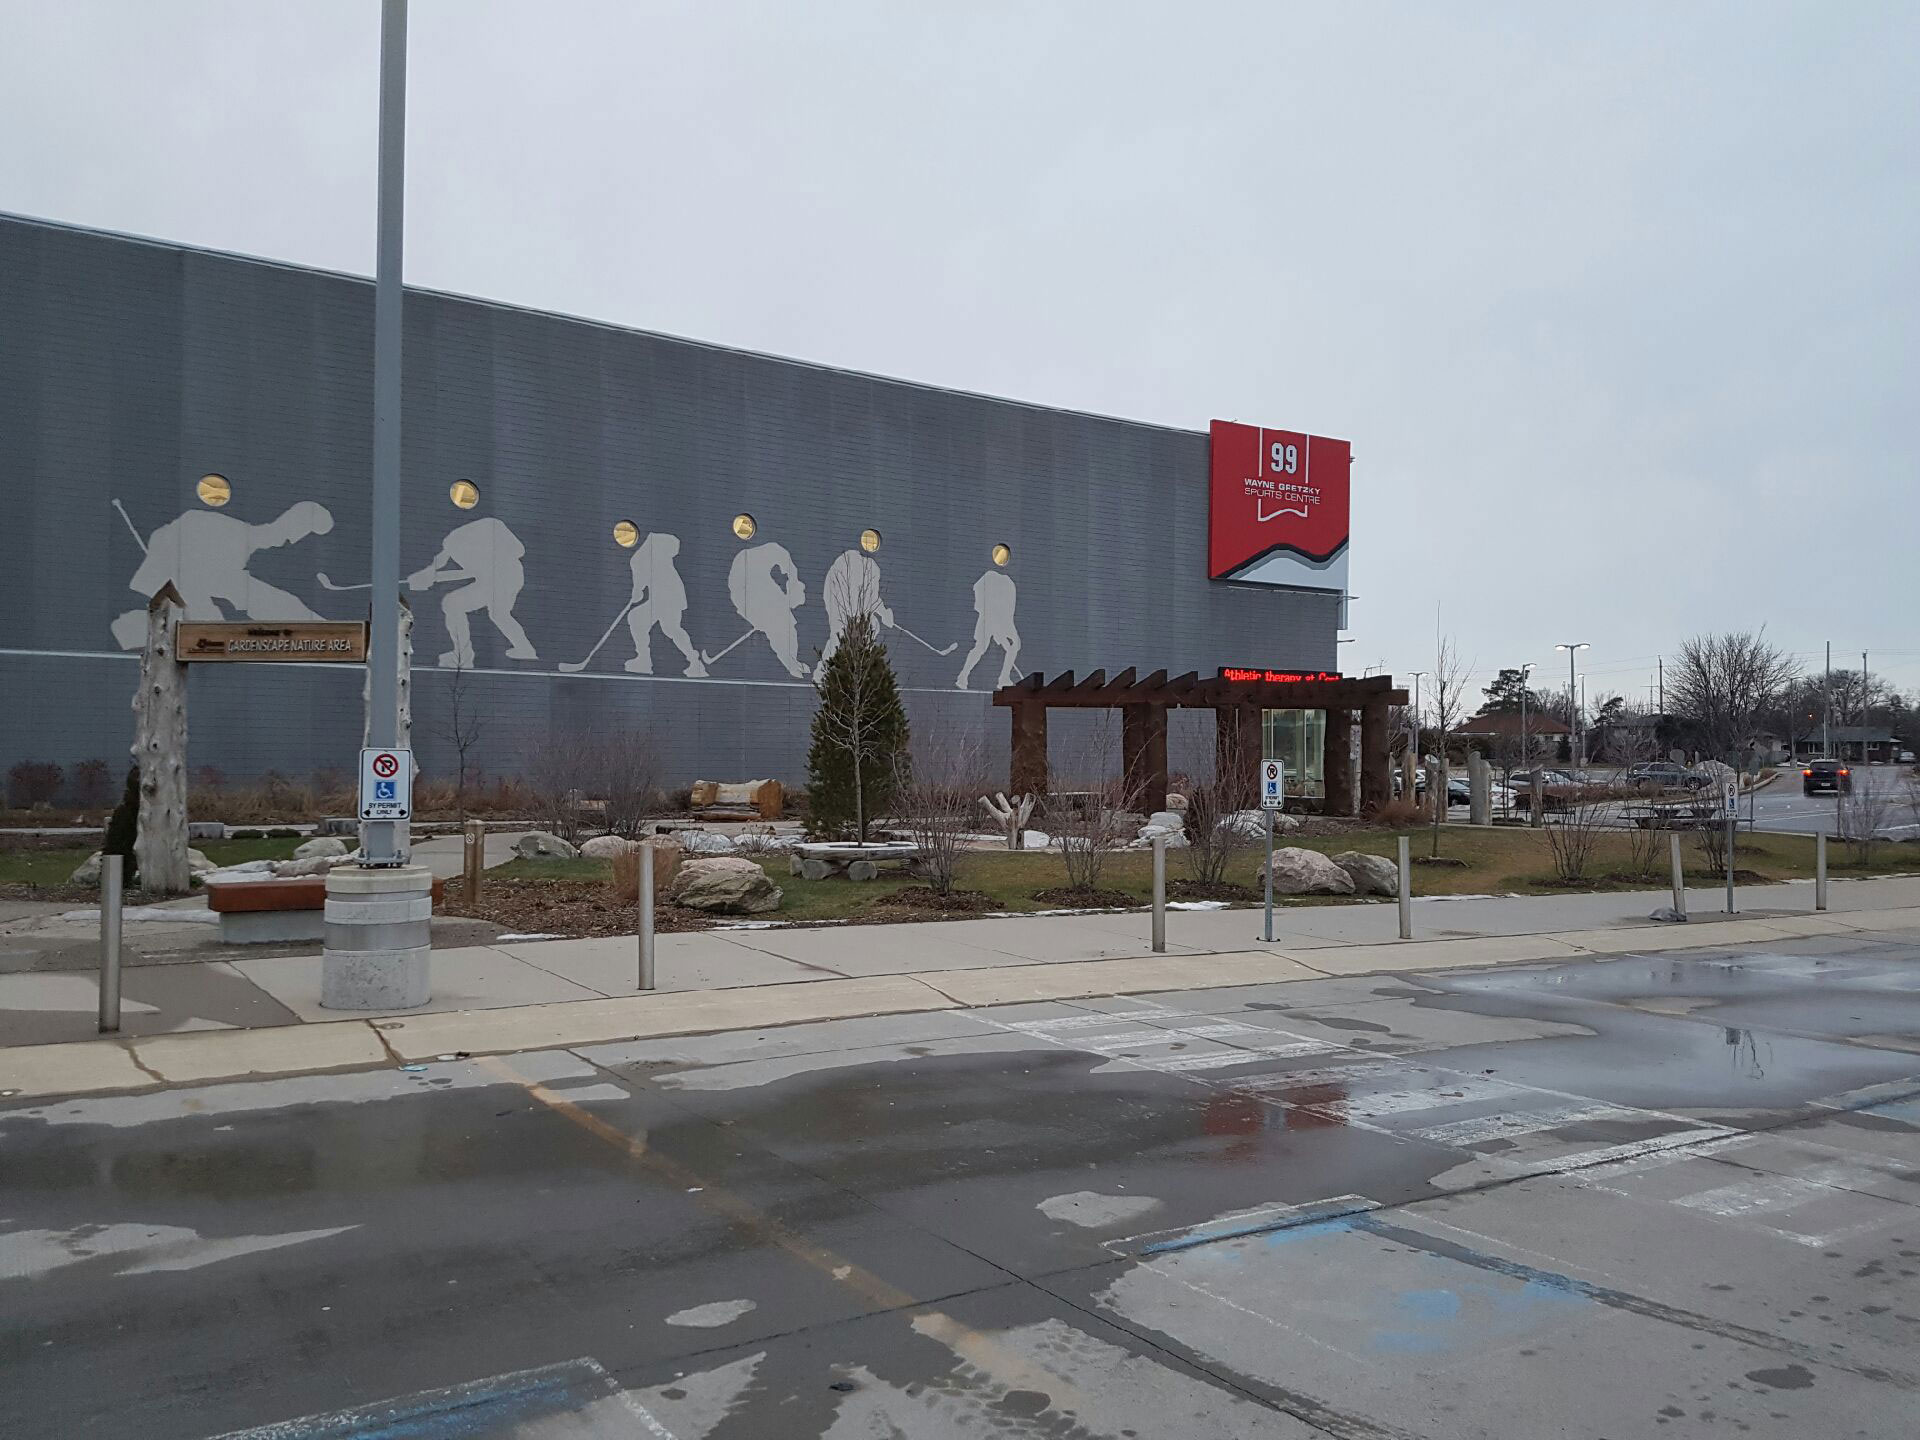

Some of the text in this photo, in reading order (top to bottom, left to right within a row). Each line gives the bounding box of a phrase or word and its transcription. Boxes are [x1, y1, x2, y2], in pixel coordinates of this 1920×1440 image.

[1271, 442, 1298, 474] 99
[1245, 478, 1320, 495] WAYNE GRETZKY
[1245, 487, 1320, 505] SPORTS CENTRE
[290, 639, 326, 653] NATURE
[328, 639, 352, 652] AREA
